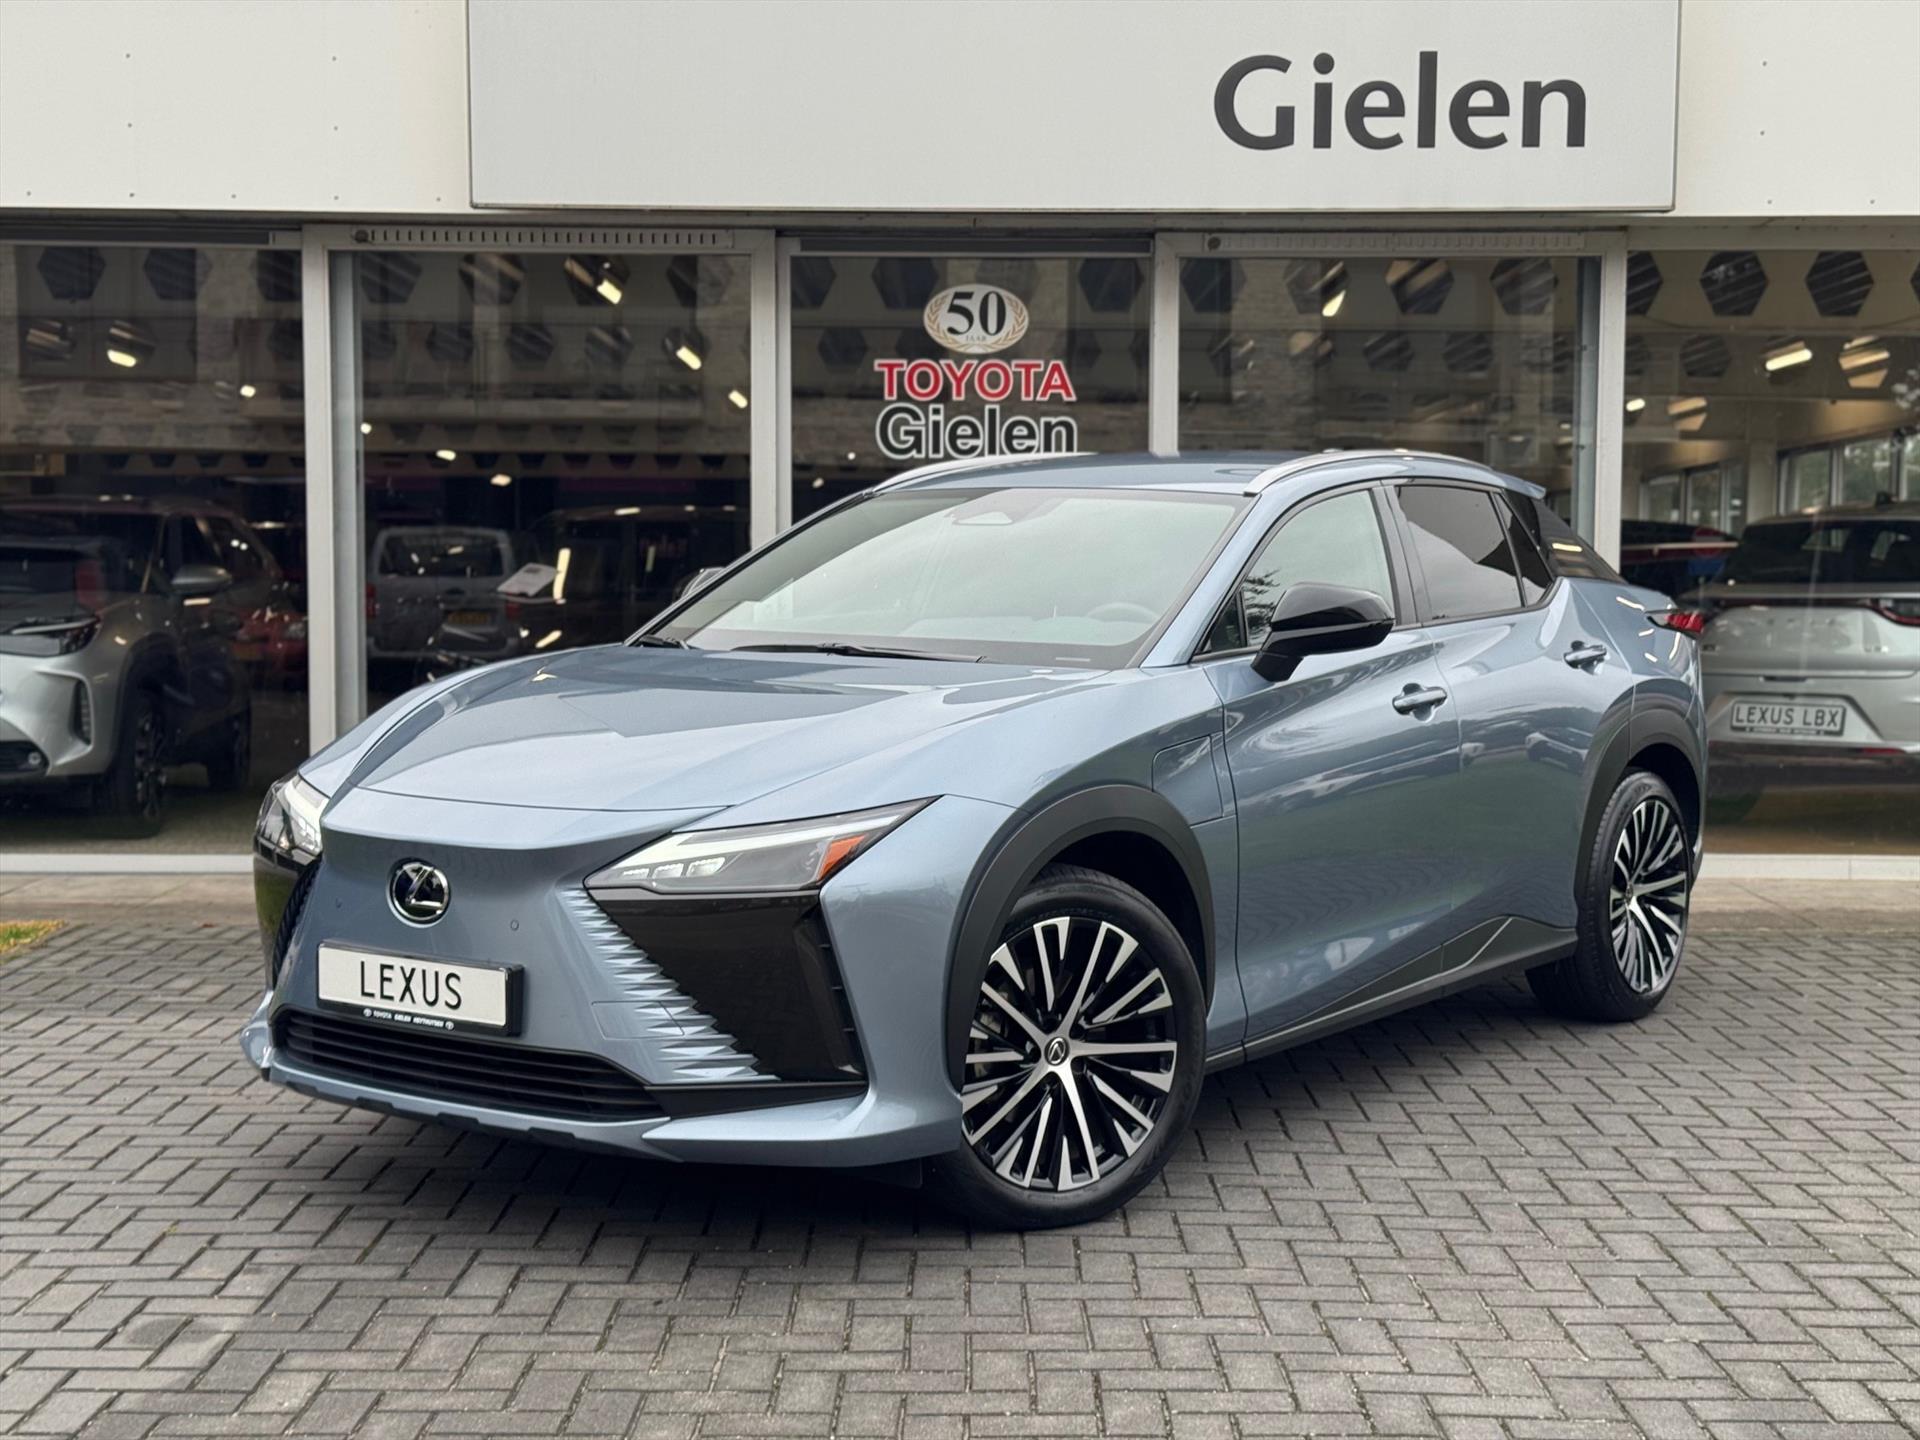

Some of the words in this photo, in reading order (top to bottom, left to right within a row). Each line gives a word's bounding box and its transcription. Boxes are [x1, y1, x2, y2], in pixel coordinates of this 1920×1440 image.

[1213, 50, 1587, 151] Gielen
[946, 290, 1008, 336] 50
[874, 358, 1077, 401] TOYOTA
[875, 402, 1078, 460] Gielen
[1735, 706, 1795, 725] LEXUS
[1802, 708, 1839, 727] LBX
[360, 960, 462, 1010] LEXUS
